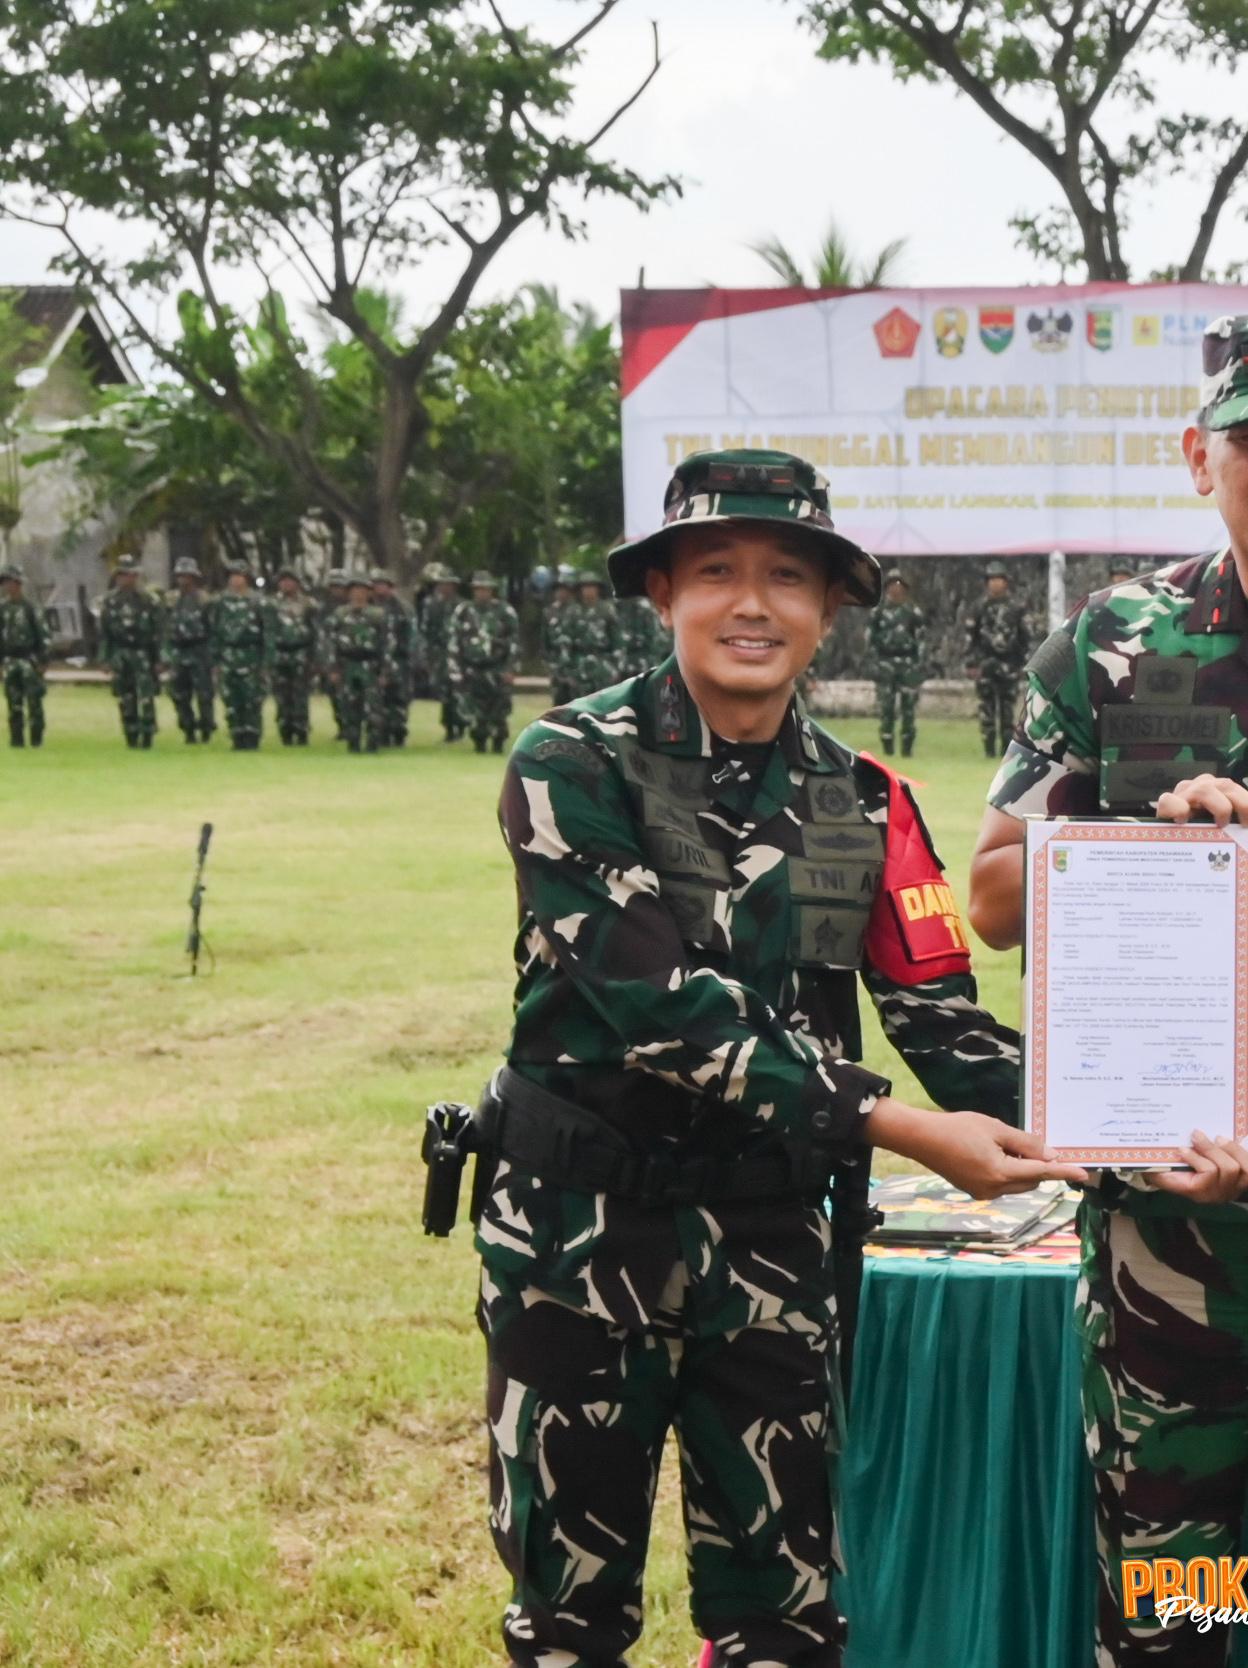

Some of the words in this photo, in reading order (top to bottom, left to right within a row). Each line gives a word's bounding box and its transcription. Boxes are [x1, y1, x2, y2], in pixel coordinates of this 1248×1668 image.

[905, 385, 1048, 418] UPACARA
[1056, 385, 1200, 418] PENUTUP
[919, 432, 1115, 465] MEMBANGUN
[1123, 432, 1190, 466] DES
[804, 867, 847, 890] TNI
